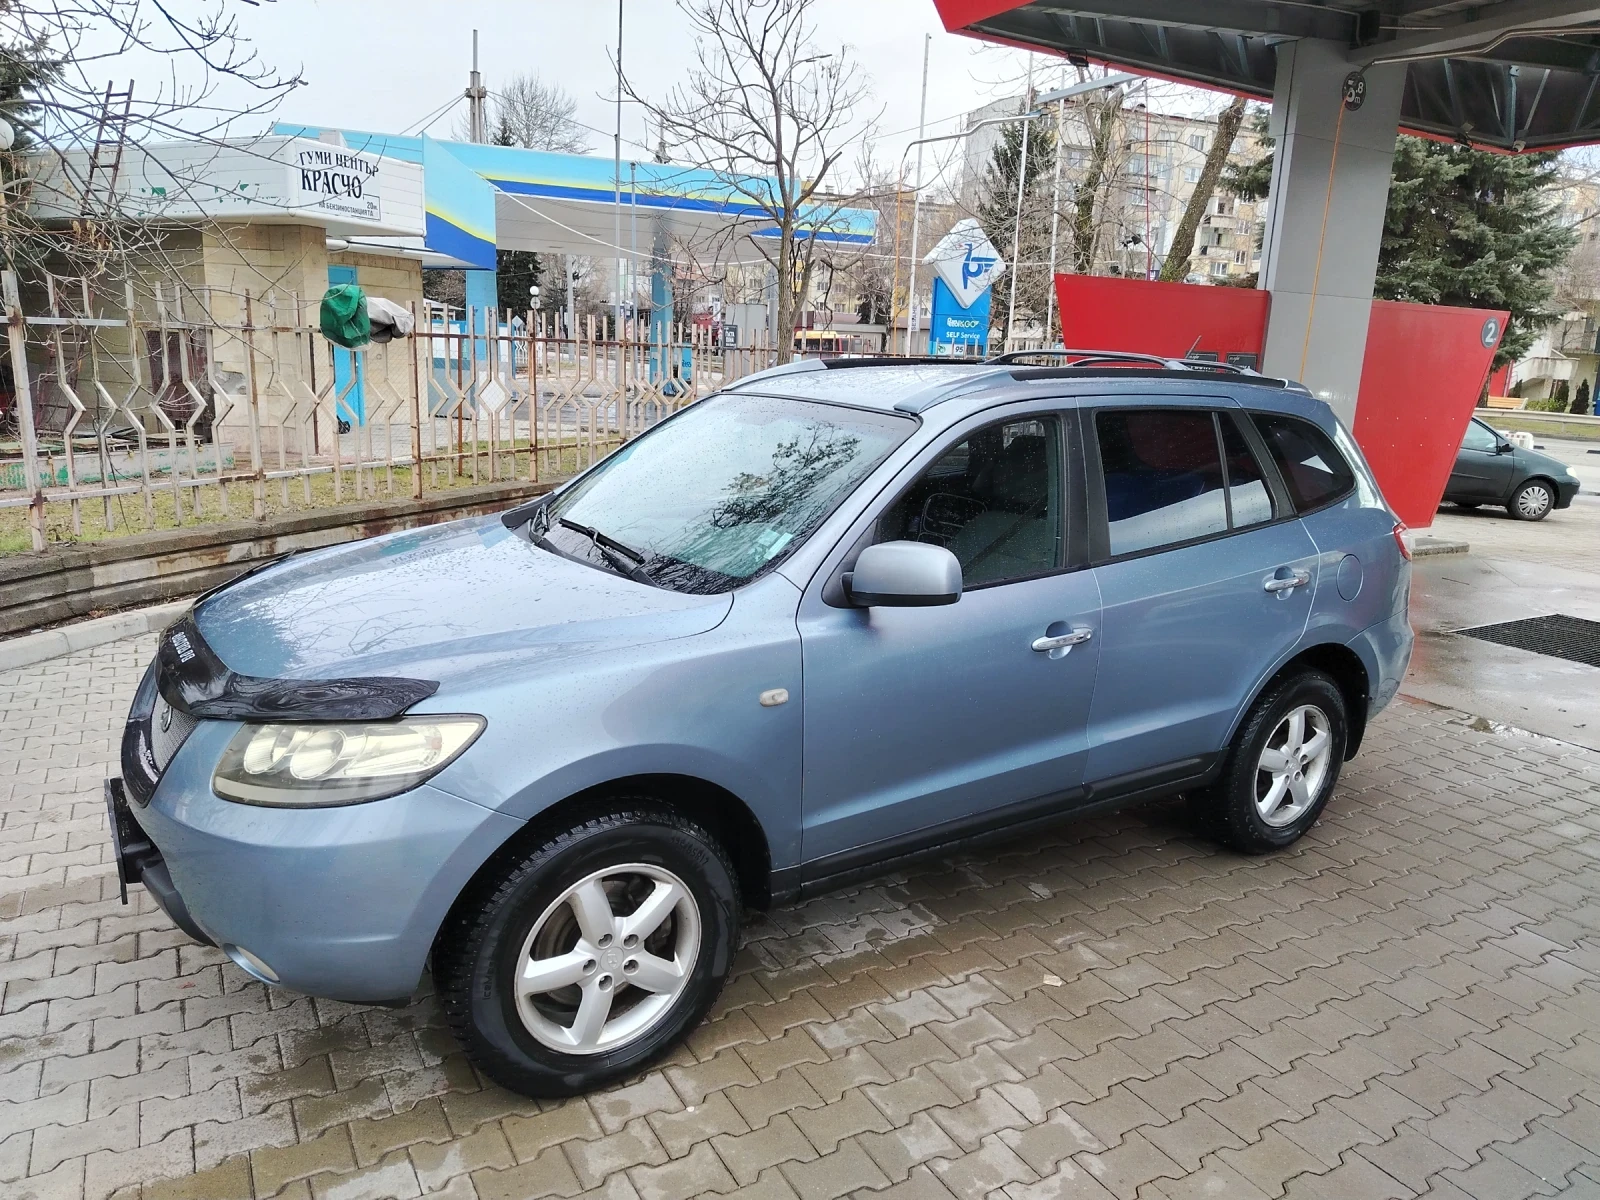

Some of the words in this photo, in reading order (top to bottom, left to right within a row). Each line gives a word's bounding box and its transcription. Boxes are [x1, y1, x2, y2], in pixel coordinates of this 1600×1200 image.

[299, 151, 332, 166] ГУМИ
[335, 153, 379, 177] ЦЕНТЪР
[301, 168, 362, 199] КРАСЧО
[945, 331, 960, 339] SELF
[960, 331, 981, 340] Service
[1485, 322, 1496, 342] 2
[955, 345, 964, 353] 95
